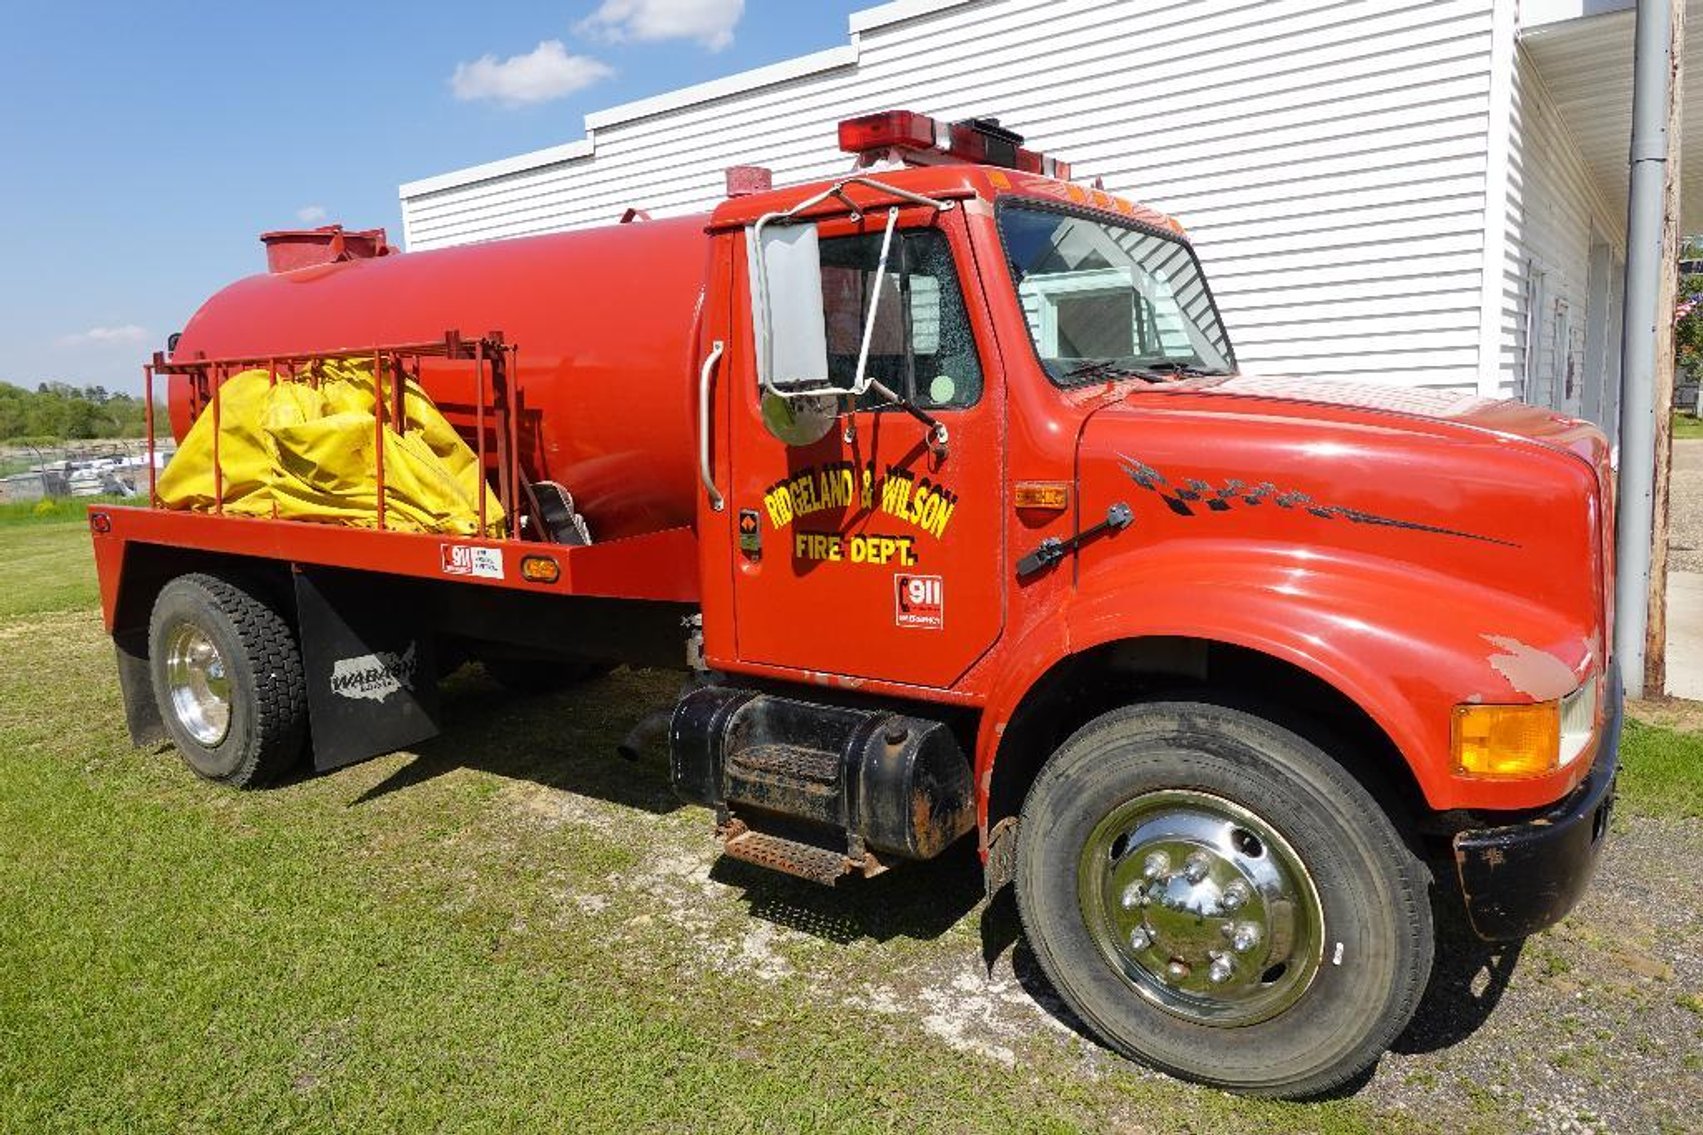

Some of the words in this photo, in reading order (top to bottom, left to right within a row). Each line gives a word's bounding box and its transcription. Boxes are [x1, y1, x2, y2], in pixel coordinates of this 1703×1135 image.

[763, 466, 854, 529] RIDGELAND
[861, 467, 873, 510] &
[882, 472, 956, 540] WILSON
[451, 546, 472, 567] 911
[796, 533, 842, 562] FIRE
[850, 536, 915, 566] DEPT.
[908, 579, 941, 605] 911
